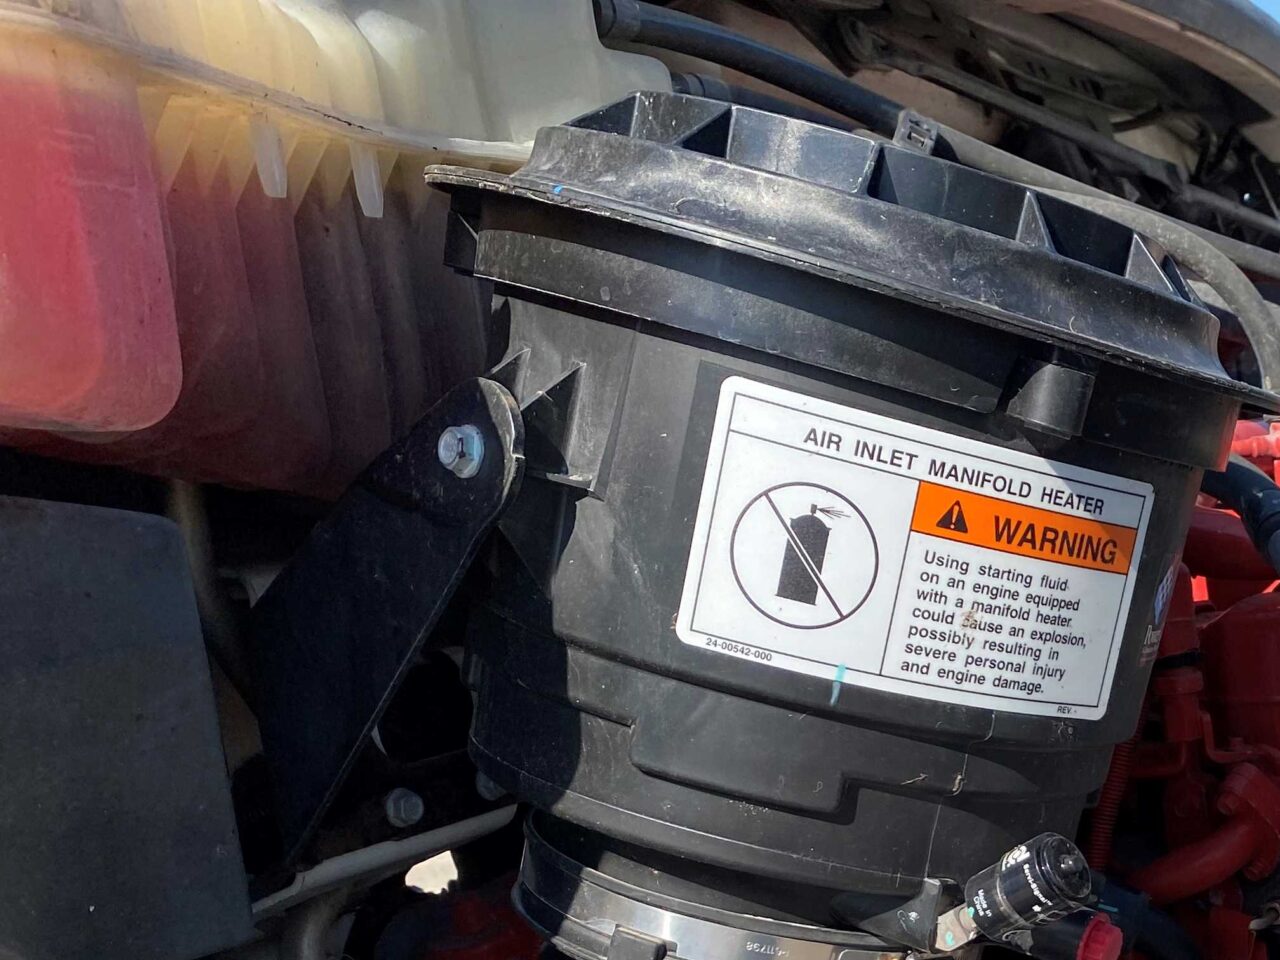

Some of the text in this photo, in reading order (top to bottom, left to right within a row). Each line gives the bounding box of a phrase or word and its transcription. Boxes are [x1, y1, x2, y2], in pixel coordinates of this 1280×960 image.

[803, 427, 1105, 515] AIR INLET MANIFOLD HEATER
[993, 515, 1118, 565] WARNING
[924, 550, 1068, 592] Using starting fluid
[916, 588, 948, 605] with
[955, 597, 964, 608] a
[971, 600, 1030, 621] manifold
[920, 571, 1080, 612] on an engine equipped
[907, 624, 1059, 661] possibly resulting in
[912, 607, 1087, 649] could cause an explosion,
[706, 637, 773, 662] 24-00542-000
[904, 643, 1066, 682] severe personal injury
[900, 660, 1045, 696] and engine damage.
[973, 896, 985, 916] China
